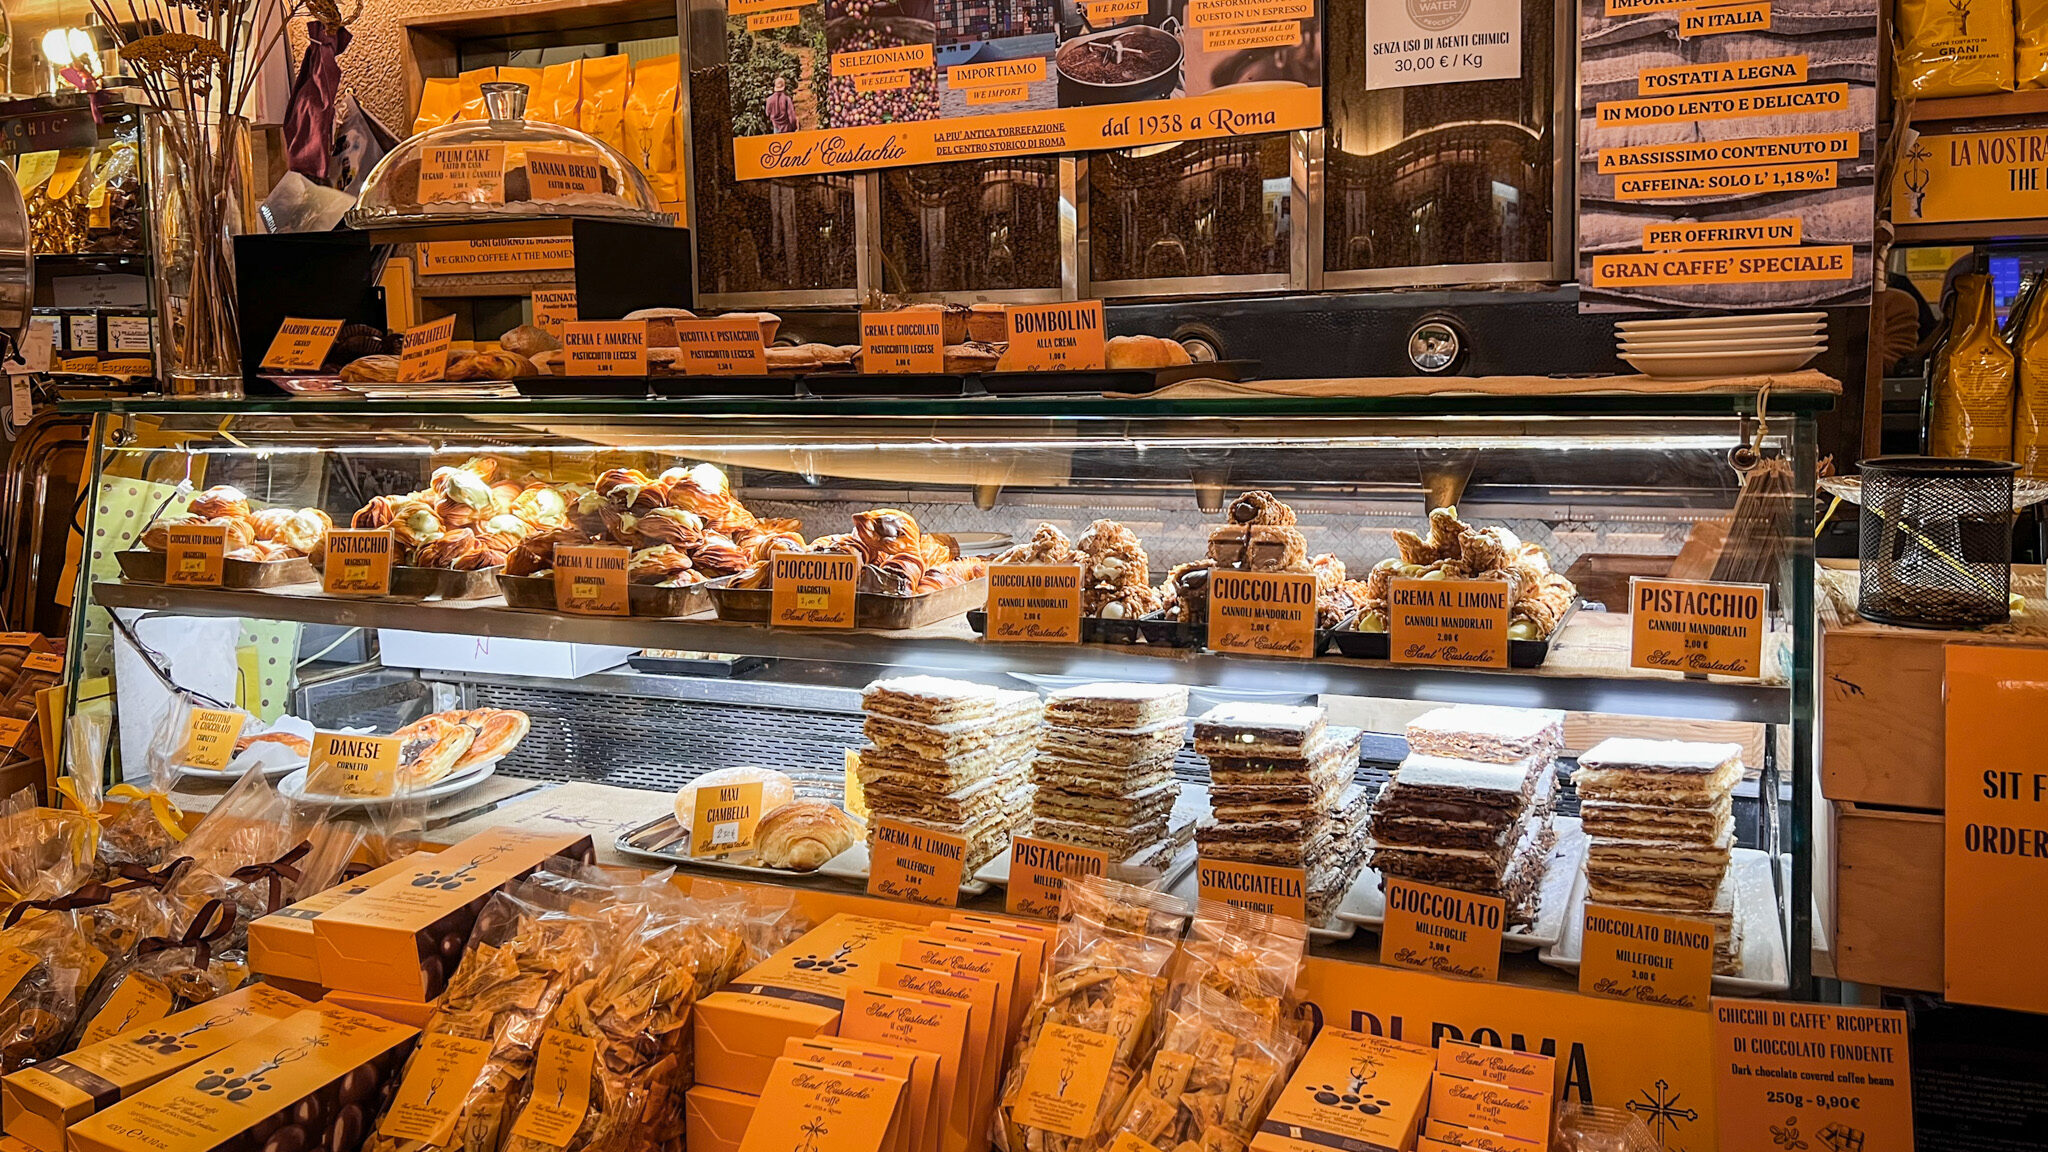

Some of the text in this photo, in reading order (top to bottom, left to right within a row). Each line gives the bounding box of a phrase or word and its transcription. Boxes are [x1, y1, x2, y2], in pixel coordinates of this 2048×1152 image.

[1095, 2, 1141, 13] WE ROAST
[1196, 5, 1307, 22] QUESTO IN UN ESPRESSO
[766, 13, 794, 23] TRAVEL
[1687, 11, 1764, 29] IN ITALIA
[1209, 40, 1225, 48] THIS
[1237, 36, 1274, 45] ESPRESSO
[1275, 34, 1295, 42] CUPS
[1221, 26, 1267, 37] TRANSFORM
[1373, 32, 1510, 55] SENZA USO DI AGENTI CHIMICI
[1939, 45, 1979, 57] GRANI
[839, 49, 924, 68] SELEZIONIAMO
[1395, 54, 1483, 72] 30,00 € / Kg
[861, 75, 905, 86] WE SELECT
[957, 62, 1037, 81] IMPORTIAMO
[1645, 64, 1797, 87] TOSTATI A LEGNA
[974, 88, 1022, 99] WE IMPORT
[1603, 91, 1841, 120] IN MODO LENTO E DELICATO
[1102, 108, 1276, 137] dal 1938 a Roma
[934, 123, 1065, 142] LA PIU' ANTICA TORREFAZIONE
[937, 137, 1066, 155] DEL CENTRO STORICO DI ROMA
[1604, 139, 1848, 166] A BASSISSIMO CONTENUTO DI
[1951, 140, 1971, 166] LA
[435, 149, 491, 163] PLUM CAKE
[531, 161, 597, 179] BANANA BREAD
[2008, 167, 2040, 191] THE
[1621, 178, 1705, 192] CAFFEINA:
[1708, 174, 1751, 187] SOLO
[1774, 169, 1830, 185] 1,18%!
[1650, 225, 1793, 243] PER OFFRIRVI UN
[435, 251, 540, 264] WE GRIND COFFEE AT THE
[1601, 254, 1843, 278] GRAN CAFFE' SPECIALE
[282, 324, 310, 336] MARRON
[865, 324, 939, 337] CREMA E CIOCCOLATO
[1015, 309, 1096, 333] BOMBOLINI
[403, 324, 452, 348] SFOGLIATELLA
[566, 333, 643, 346] CREMA E AMARENE
[680, 330, 760, 343] RICOTTA E PISTACCHIO
[1037, 337, 1077, 348] ALLA CREMA
[330, 536, 388, 554] PISTACCHIO
[556, 554, 625, 570] CREMA AL LIMONE
[777, 559, 854, 582] CIOCCOLATO
[796, 584, 831, 595] ARAGOSTINA
[992, 574, 1076, 588] CIOCCOLATO BIANCO
[1214, 578, 1312, 605] CIOCCOLATO
[1394, 590, 1505, 609] CREMA AL LIMONE
[998, 597, 1068, 609] CANNOLI MANDORLATI
[1641, 588, 1758, 620] PISTACCHIO
[1221, 606, 1301, 621] CANNOLI MANDORLATI
[1404, 616, 1493, 630] CANNOLI MANDORLATI
[1648, 620, 1747, 639] CANNOLI MANDORLATI
[330, 739, 382, 760] DANESE
[337, 760, 368, 771] CORNETTO
[720, 788, 738, 801] MAXI
[1983, 770, 2022, 800] SIT
[707, 806, 749, 822] CIAMBELLA
[879, 826, 962, 861] CREMA AL LIMONE
[1965, 824, 2048, 858] ORDER
[896, 857, 935, 876] MILLEFOGLIE
[1202, 869, 1302, 898] STRACCIATELLA
[1390, 886, 1500, 930] CIOCCOLATO
[1416, 921, 1467, 942] MILLEFOGLIE
[1586, 915, 1709, 950] CIOCCOLATO BIANCO
[1616, 950, 1674, 970] MILLEFOGLIE
[1719, 1007, 1902, 1034] CHICCHI DI CAFFE' RICOPERTI
[1734, 1037, 1894, 1063] DI CIOCCOLATO FONDENTE
[1732, 1063, 1894, 1086] Dark chocolate covered coffee beans
[1766, 1091, 1860, 1109] 250g 9,90€
